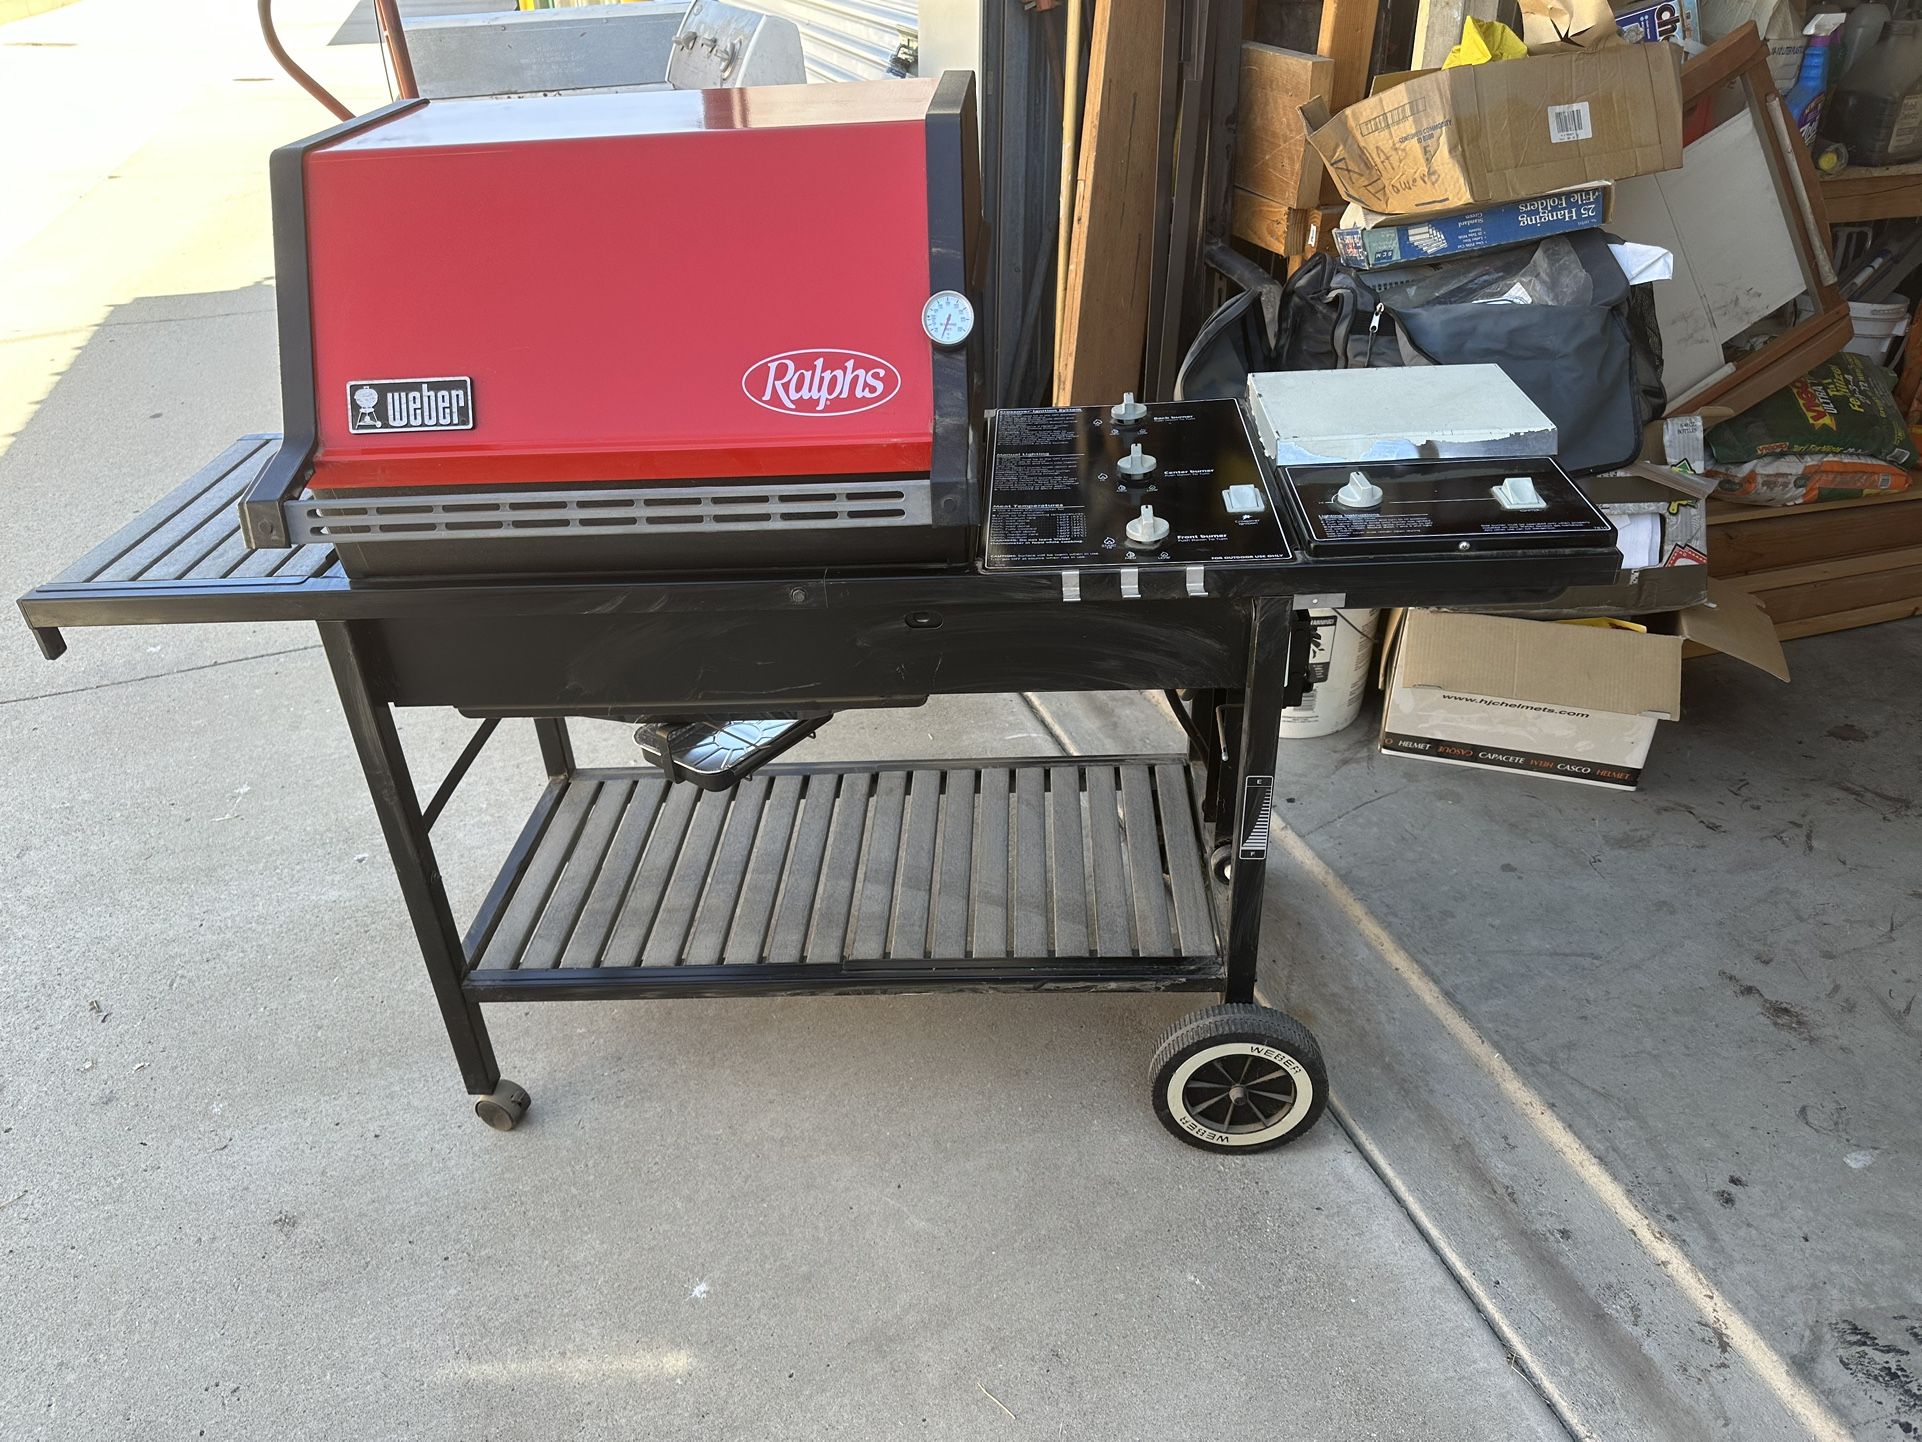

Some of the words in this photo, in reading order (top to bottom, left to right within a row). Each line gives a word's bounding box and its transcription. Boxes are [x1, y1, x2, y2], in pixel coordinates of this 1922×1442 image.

[1518, 194, 1567, 212] Folders
[1570, 191, 1594, 203] File
[1458, 217, 1484, 228] Standard
[1518, 207, 1577, 227] Hanging
[1581, 204, 1596, 218] 25
[762, 357, 886, 410] Ralphs
[387, 383, 464, 427] weber
[1442, 693, 1590, 718] www.hjchelmets.com
[1398, 740, 1432, 751] HELMET
[1478, 751, 1526, 764] CAPACETE
[1556, 762, 1591, 774] CASCO
[1596, 769, 1631, 780] HELMET
[1250, 1045, 1301, 1074] WEBER
[1180, 1115, 1229, 1143] WEBER
